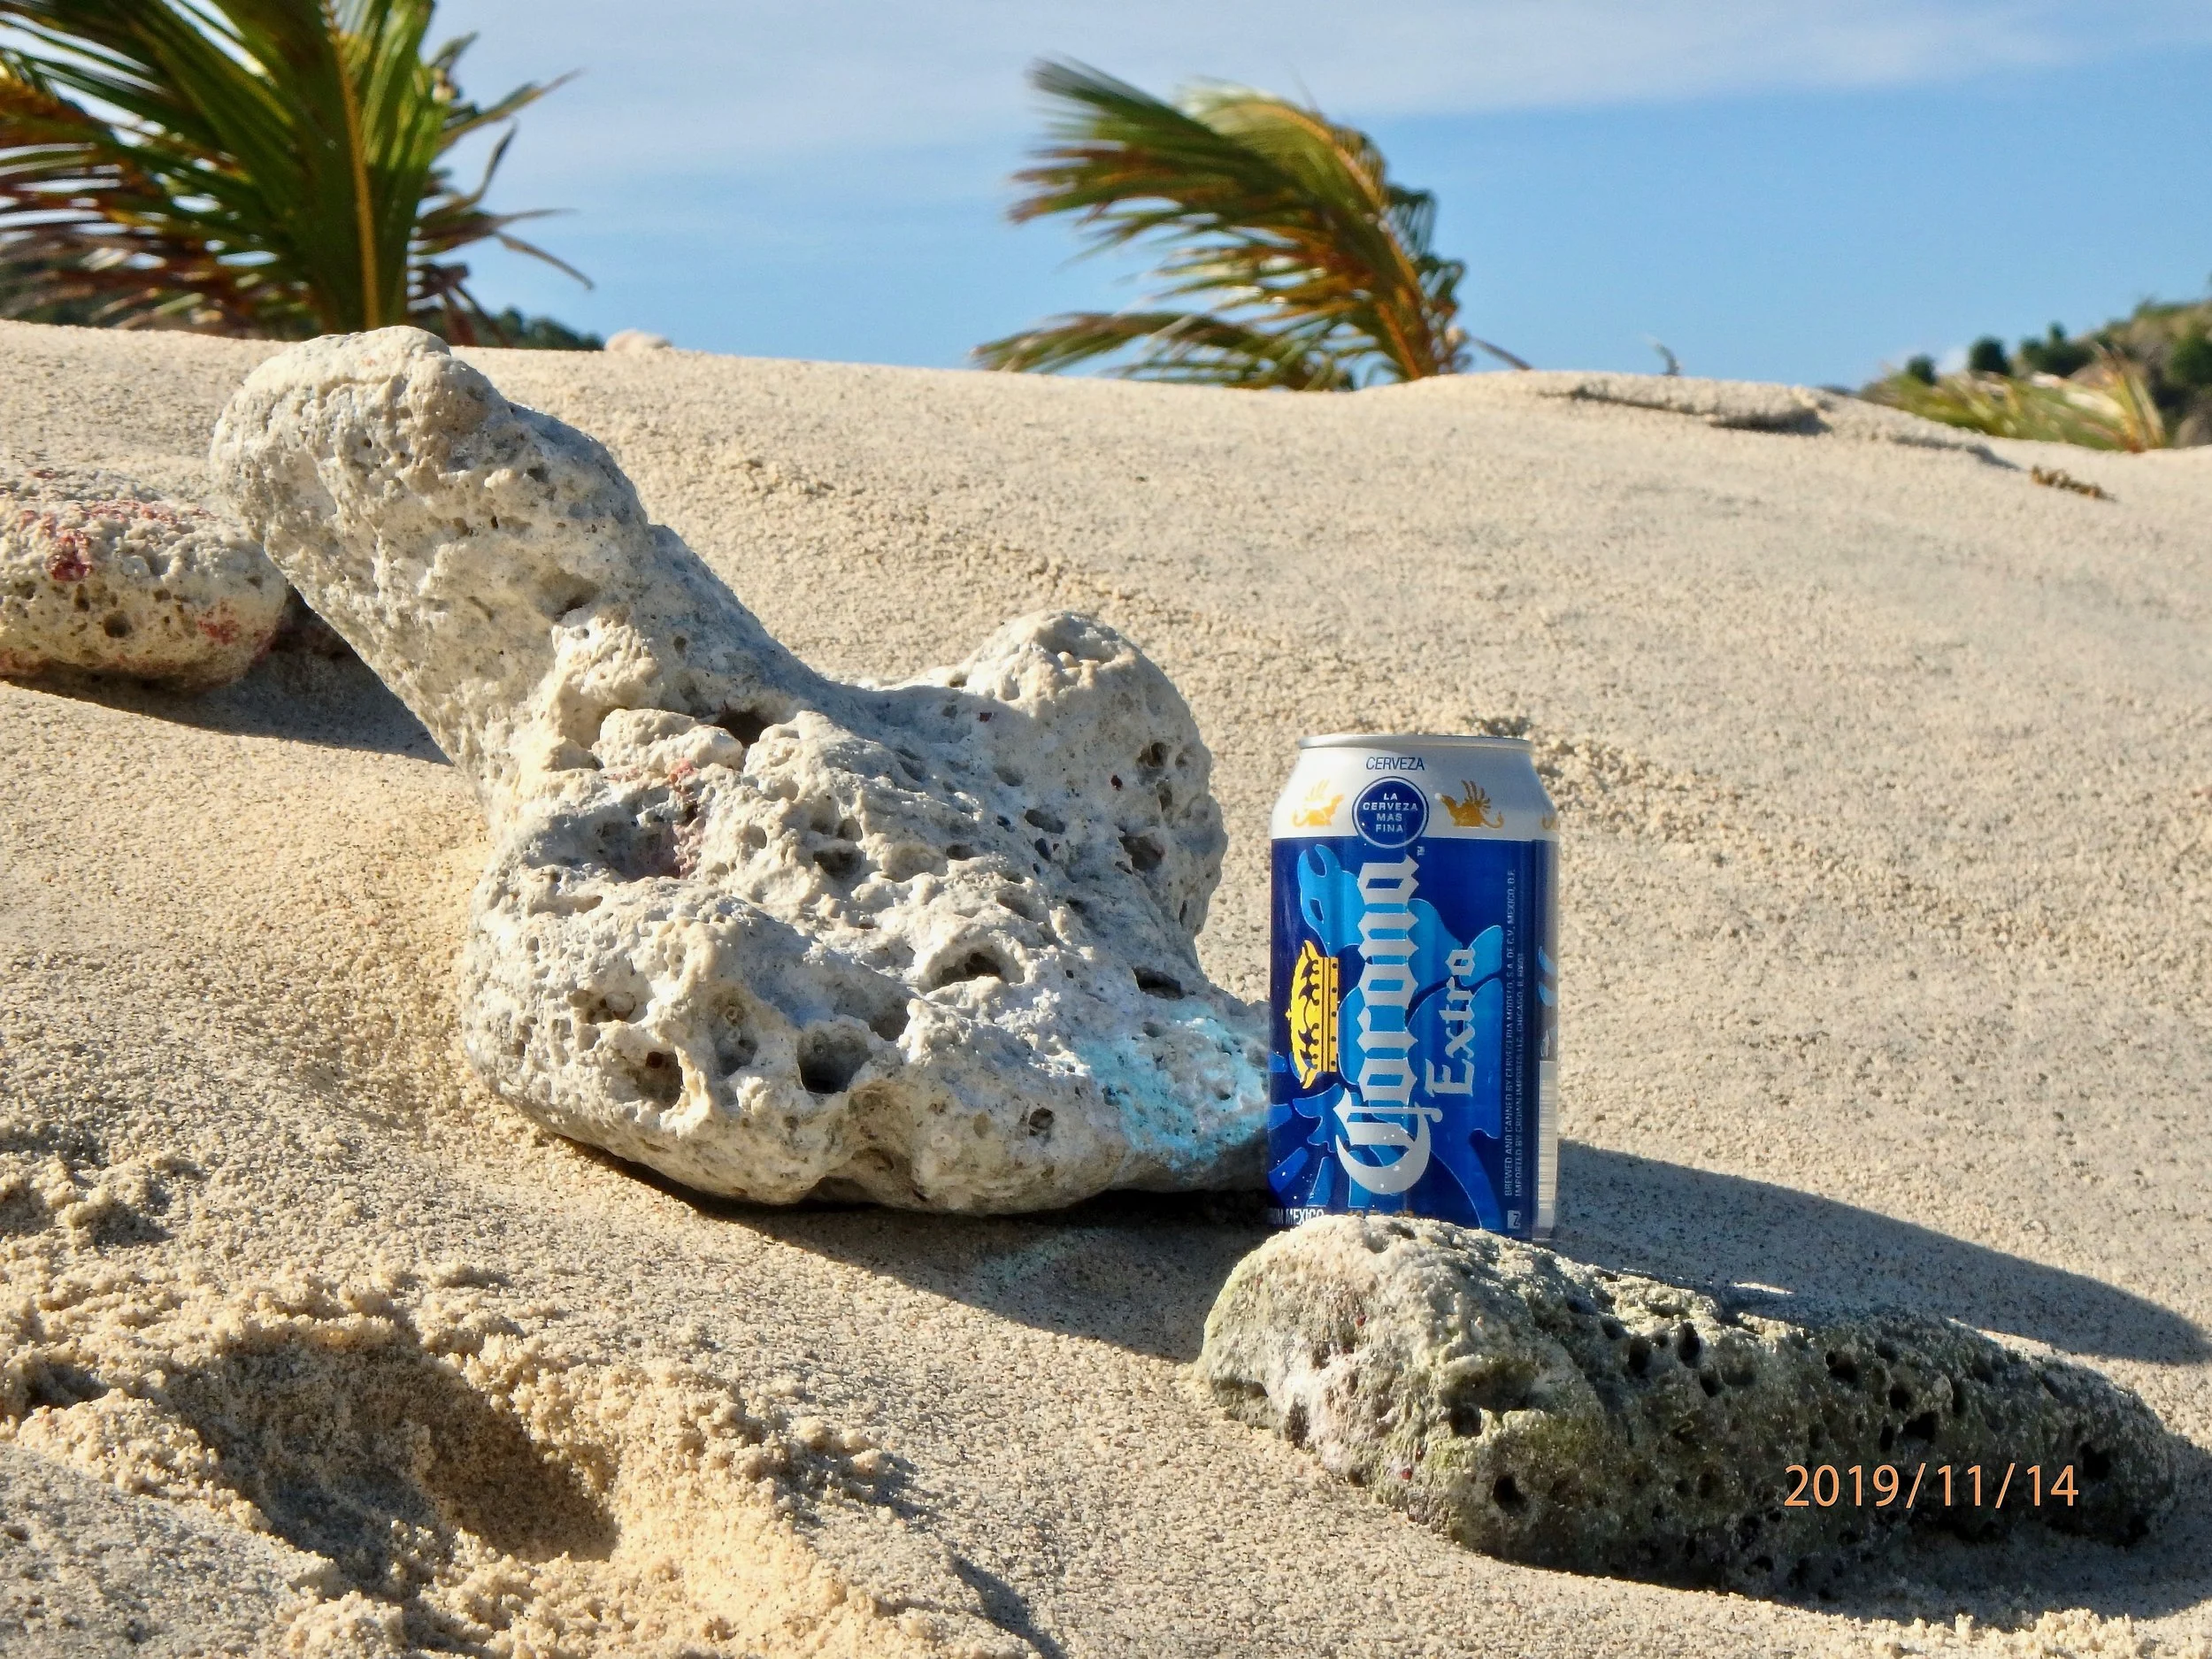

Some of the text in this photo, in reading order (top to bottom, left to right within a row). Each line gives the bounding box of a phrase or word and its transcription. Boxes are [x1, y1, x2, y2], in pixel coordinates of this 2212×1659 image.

[1366, 757, 1425, 771] CERVEZA
[1363, 802, 1418, 811] CERVEZA
[1376, 813, 1402, 822] MAS
[1375, 824, 1403, 833] FINA
[1506, 948, 1515, 958] DE
[1333, 855, 1442, 1195] Corona
[1425, 947, 1475, 1098] Extra
[1505, 1079, 1513, 1092] BY
[1504, 1134, 1513, 1155] AND
[1515, 1133, 1523, 1147] BY
[1504, 1157, 1513, 1196] BREWED
